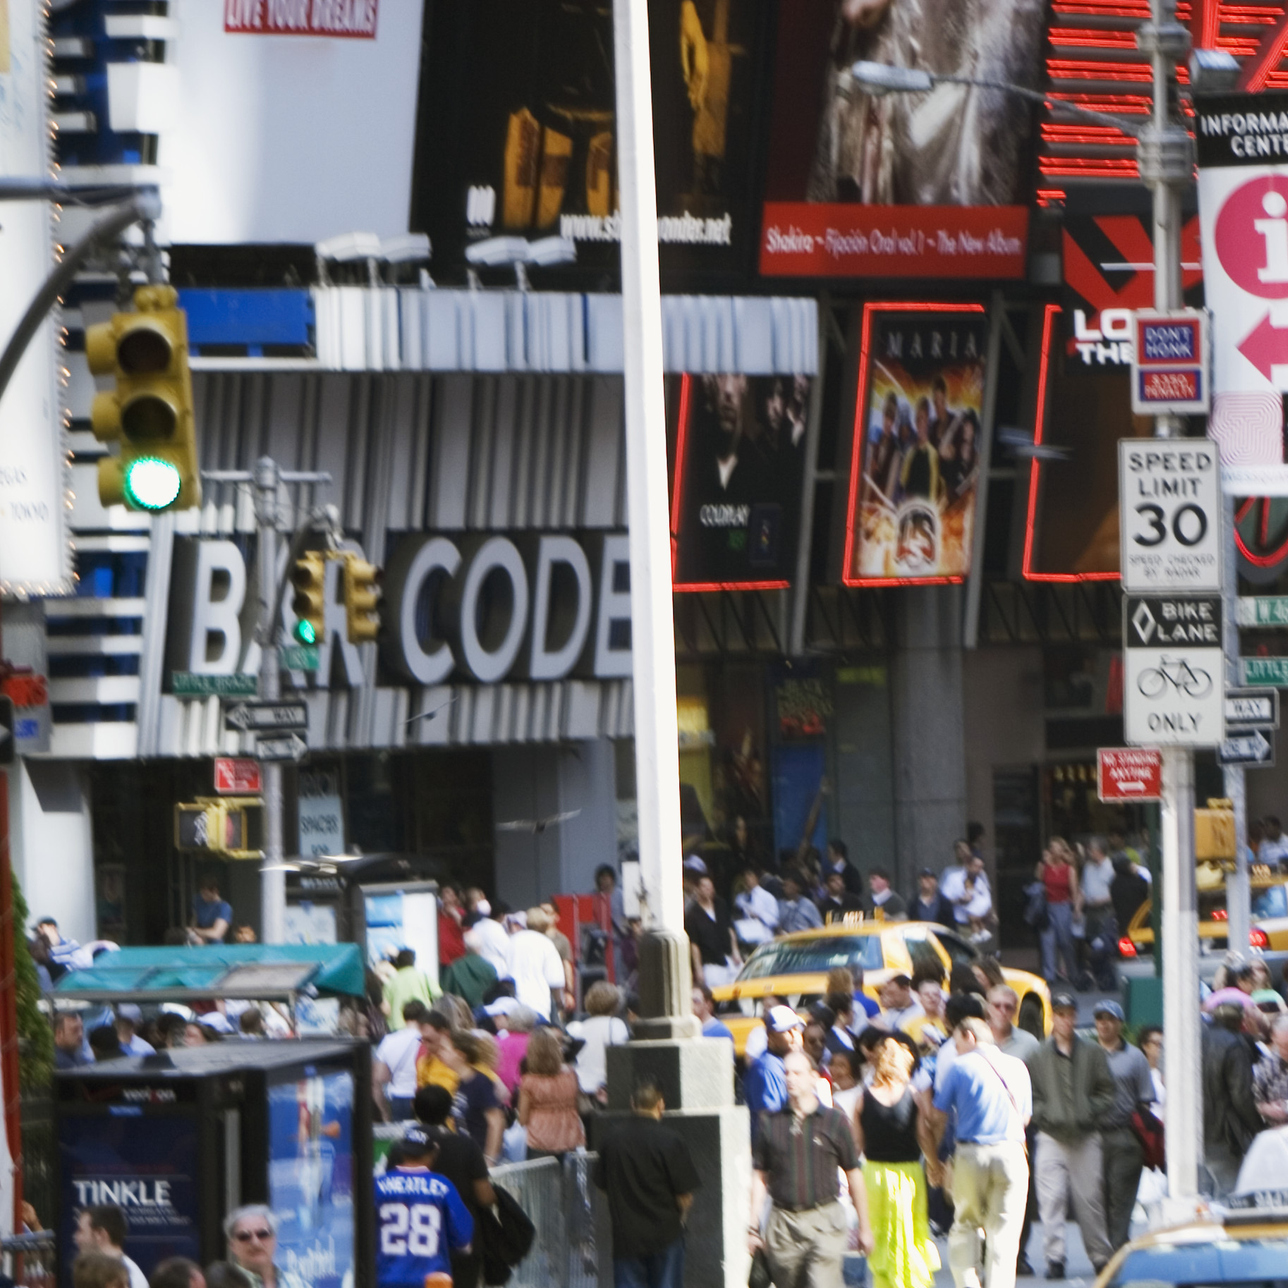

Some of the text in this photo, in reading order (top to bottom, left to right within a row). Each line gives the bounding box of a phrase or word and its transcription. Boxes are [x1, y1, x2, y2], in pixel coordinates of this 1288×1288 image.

[766, 224, 814, 254] Shakira
[958, 229, 984, 254] New
[986, 227, 1021, 255] Album
[1146, 341, 1192, 358] HONK
[1129, 452, 1211, 473] SPEED
[1138, 478, 1201, 498] LIMIT
[1132, 502, 1208, 547] 30
[1129, 554, 1162, 566] SPEED
[402, 535, 632, 685] CODE
[1161, 602, 1216, 621] BIKE
[1257, 601, 1270, 622] W
[1157, 622, 1218, 642] LANE
[1233, 701, 1263, 717] WAY
[1147, 713, 1203, 732] ONLY
[1103, 752, 1159, 766] NO STANDING
[1109, 766, 1153, 780] ANYTIME
[72, 1180, 173, 1207] TINKLE
[380, 1202, 441, 1258] 28
